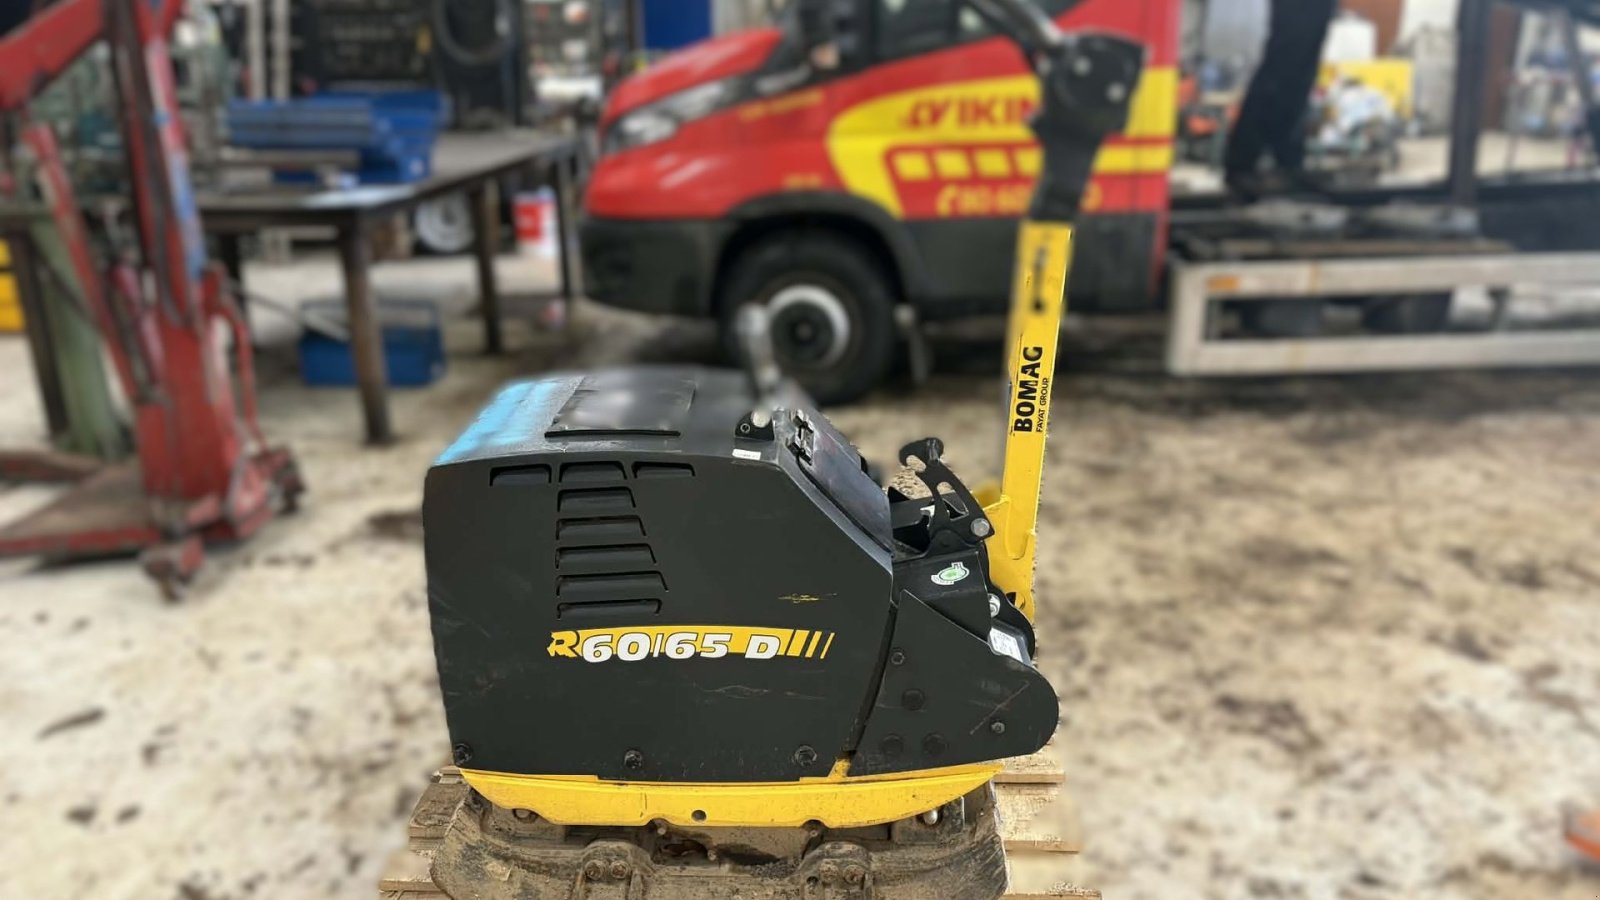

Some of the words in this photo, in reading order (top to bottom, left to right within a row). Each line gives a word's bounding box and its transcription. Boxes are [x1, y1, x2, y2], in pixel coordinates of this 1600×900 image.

[1013, 346, 1043, 433] BOMAG
[1040, 378, 1050, 406] GROUP
[1036, 409, 1045, 433] FAYAT
[745, 634, 781, 659] D
